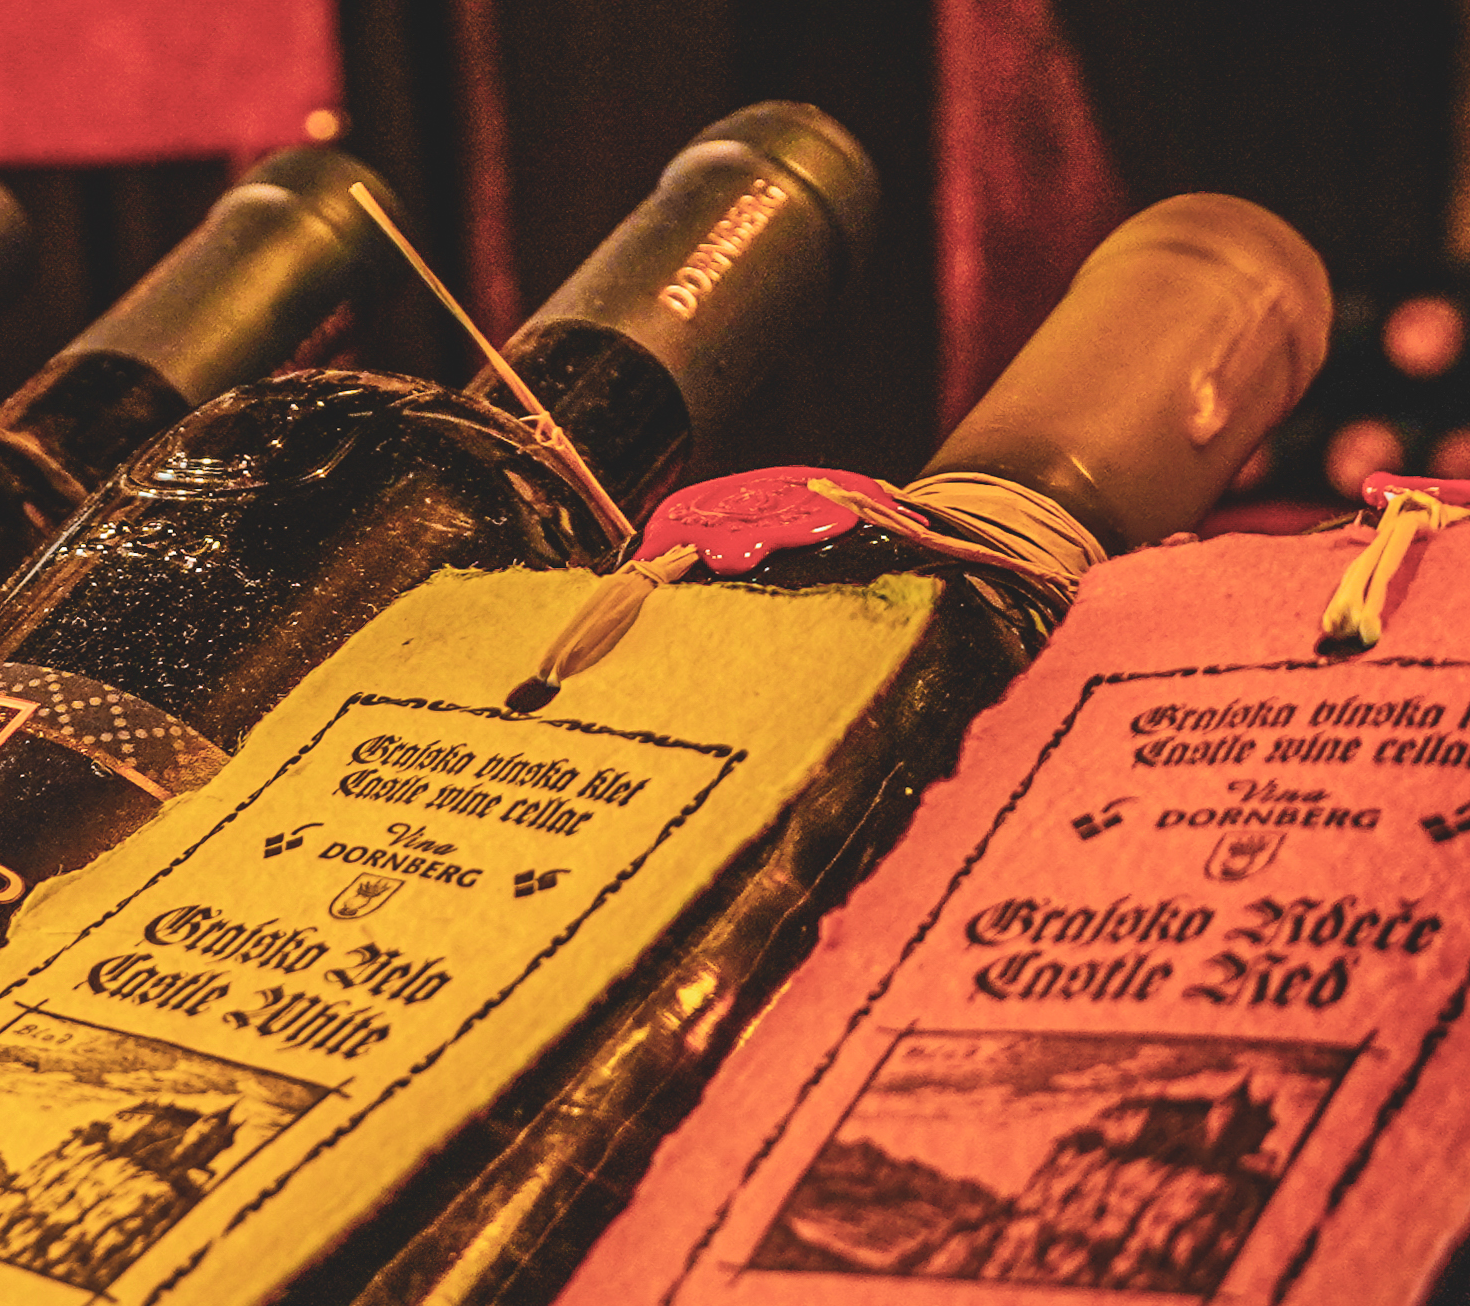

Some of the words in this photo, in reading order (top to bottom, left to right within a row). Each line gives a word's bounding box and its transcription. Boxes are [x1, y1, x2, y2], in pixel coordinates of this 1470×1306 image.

[346, 735, 476, 774] Grajska
[1131, 732, 1257, 769] Castle
[1264, 731, 1362, 764] wine
[332, 768, 431, 805] Castle
[424, 782, 502, 819] wine
[499, 797, 595, 836] cellar
[1155, 806, 1382, 830] DORNBERG
[318, 841, 484, 888] DORNBERG
[134, 904, 330, 975] Grajsko
[964, 894, 1216, 949] Grajsko
[73, 952, 231, 1017] Castle
[222, 984, 391, 1059] White
[967, 948, 1173, 1004] Castle
[1182, 948, 1359, 1010] Red
